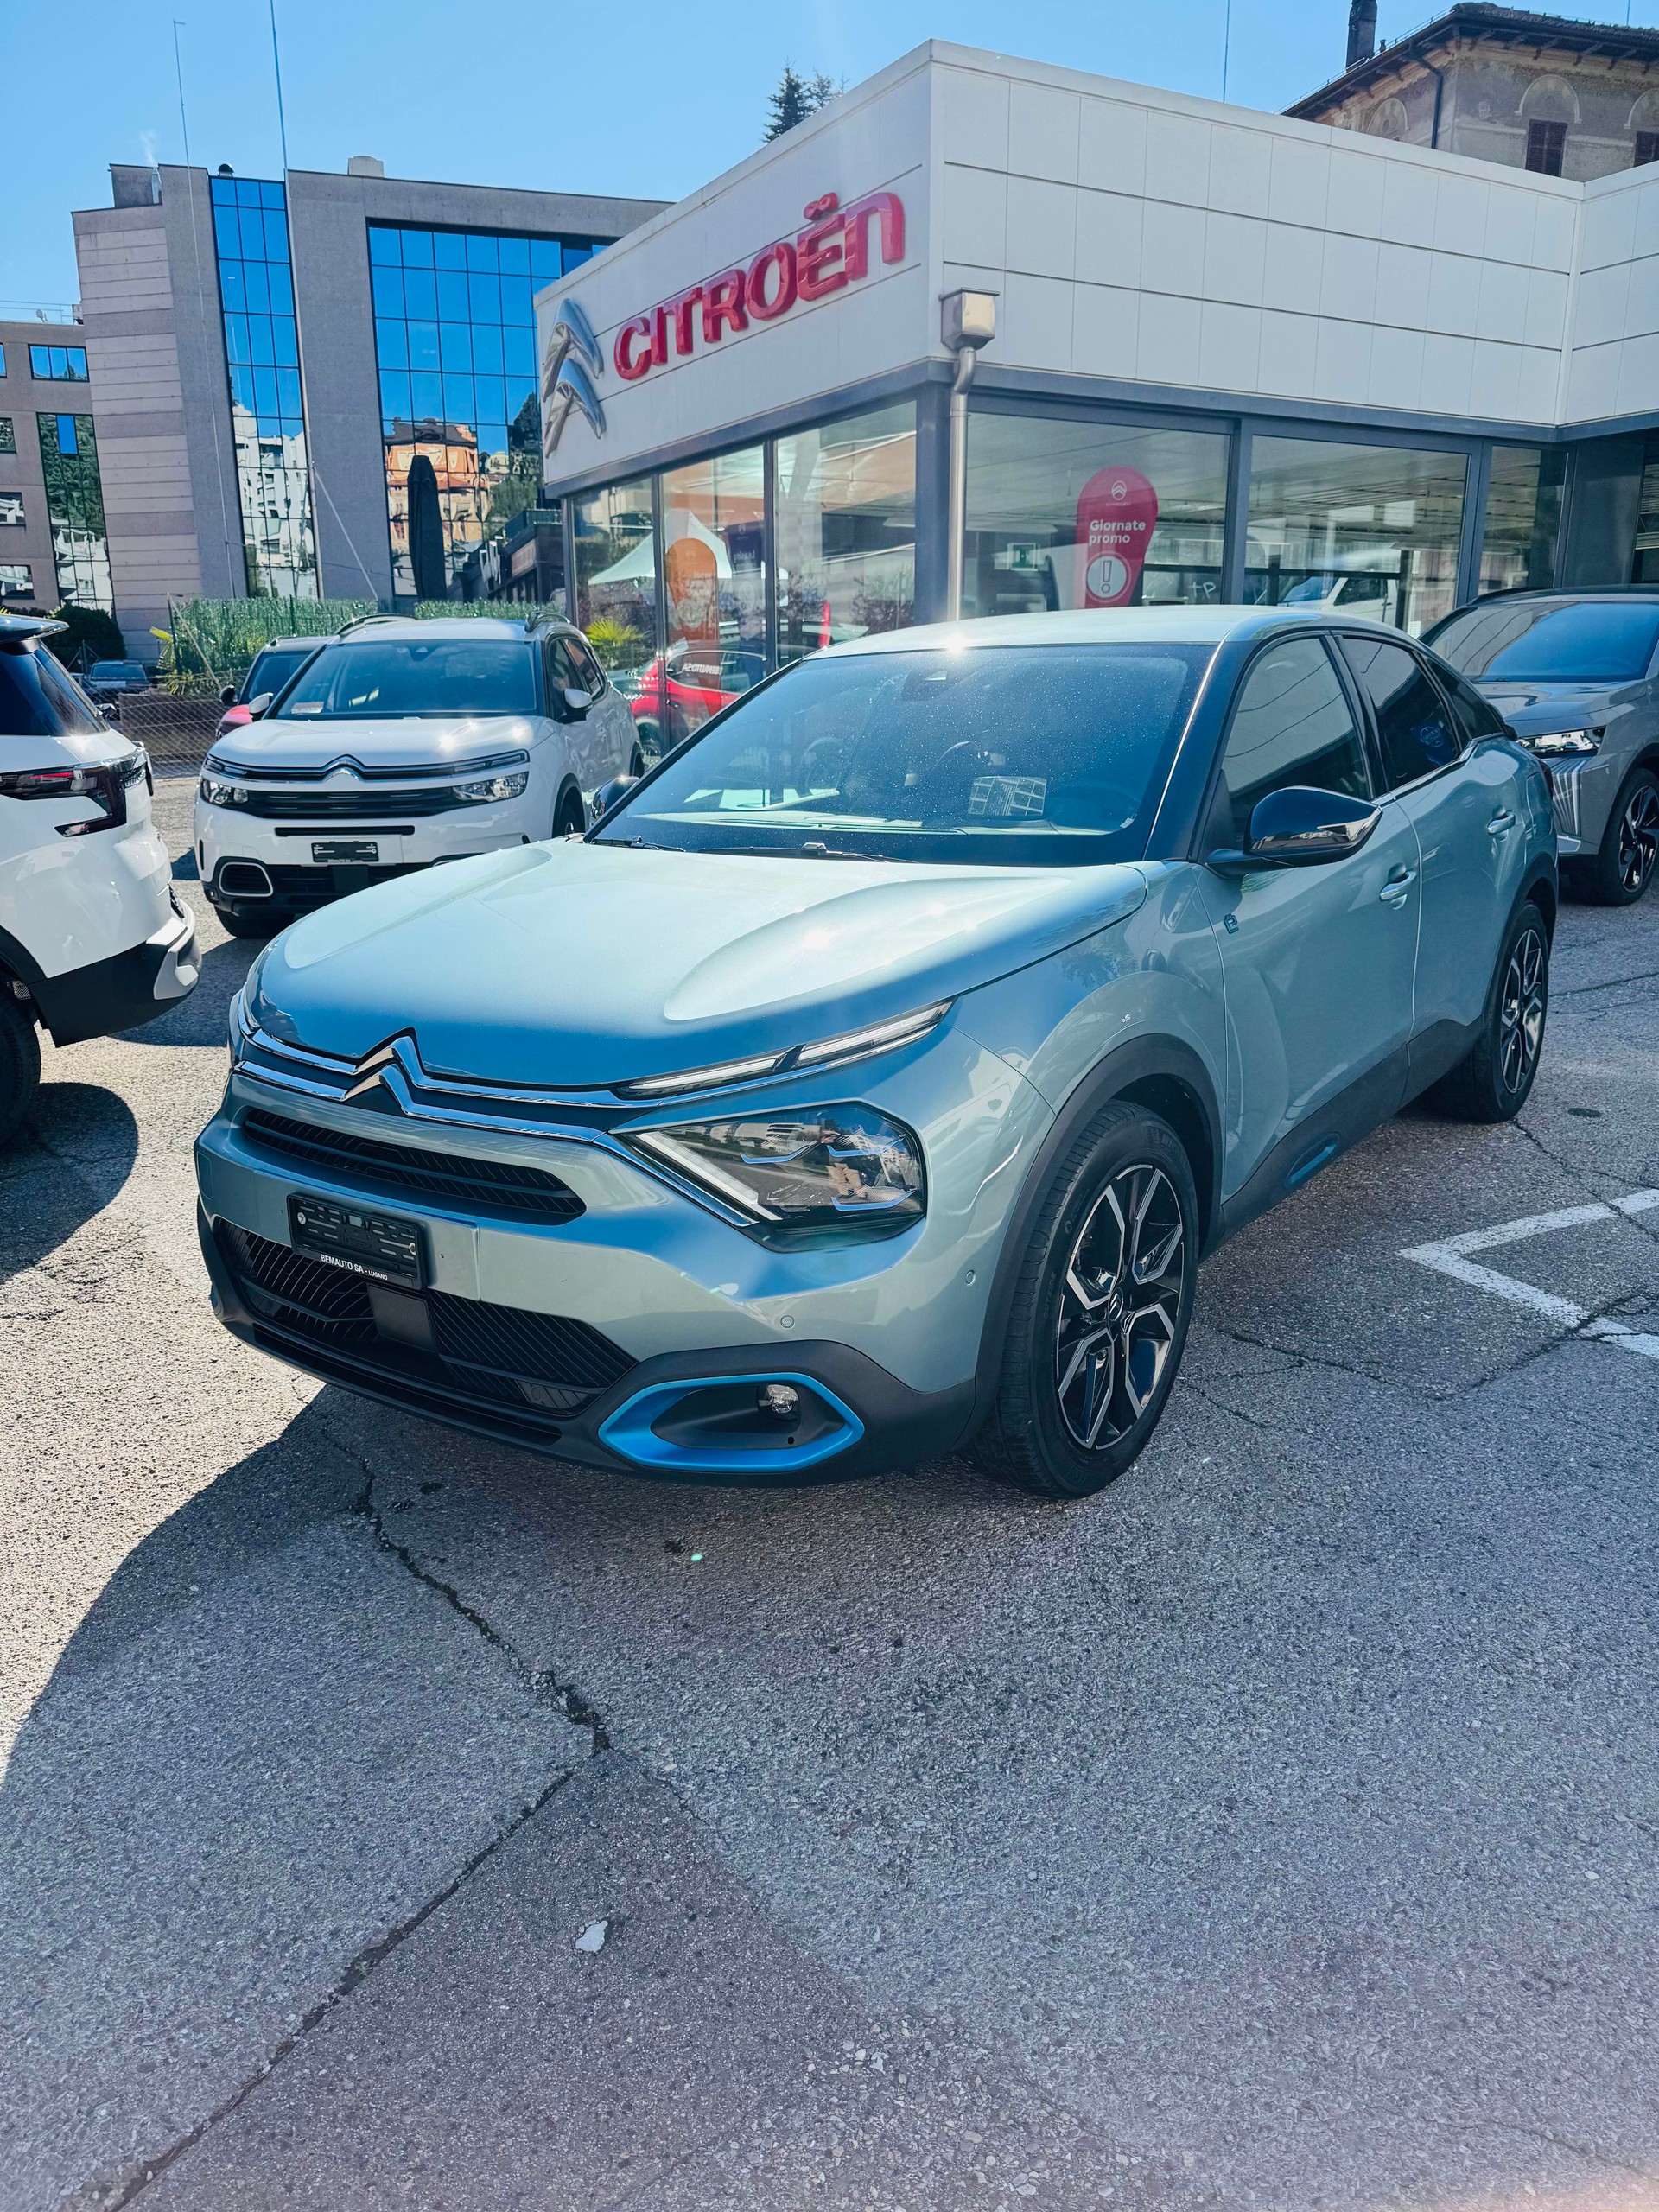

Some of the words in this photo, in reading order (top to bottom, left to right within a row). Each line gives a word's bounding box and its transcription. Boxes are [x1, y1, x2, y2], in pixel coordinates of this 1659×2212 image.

[613, 192, 905, 381] CITROËN
[1090, 519, 1146, 531] Giornate
[1089, 534, 1130, 546] promo
[321, 1254, 353, 1270] BEMAUTO
[353, 1263, 364, 1274] SA
[368, 1270, 388, 1281] LUGANO
